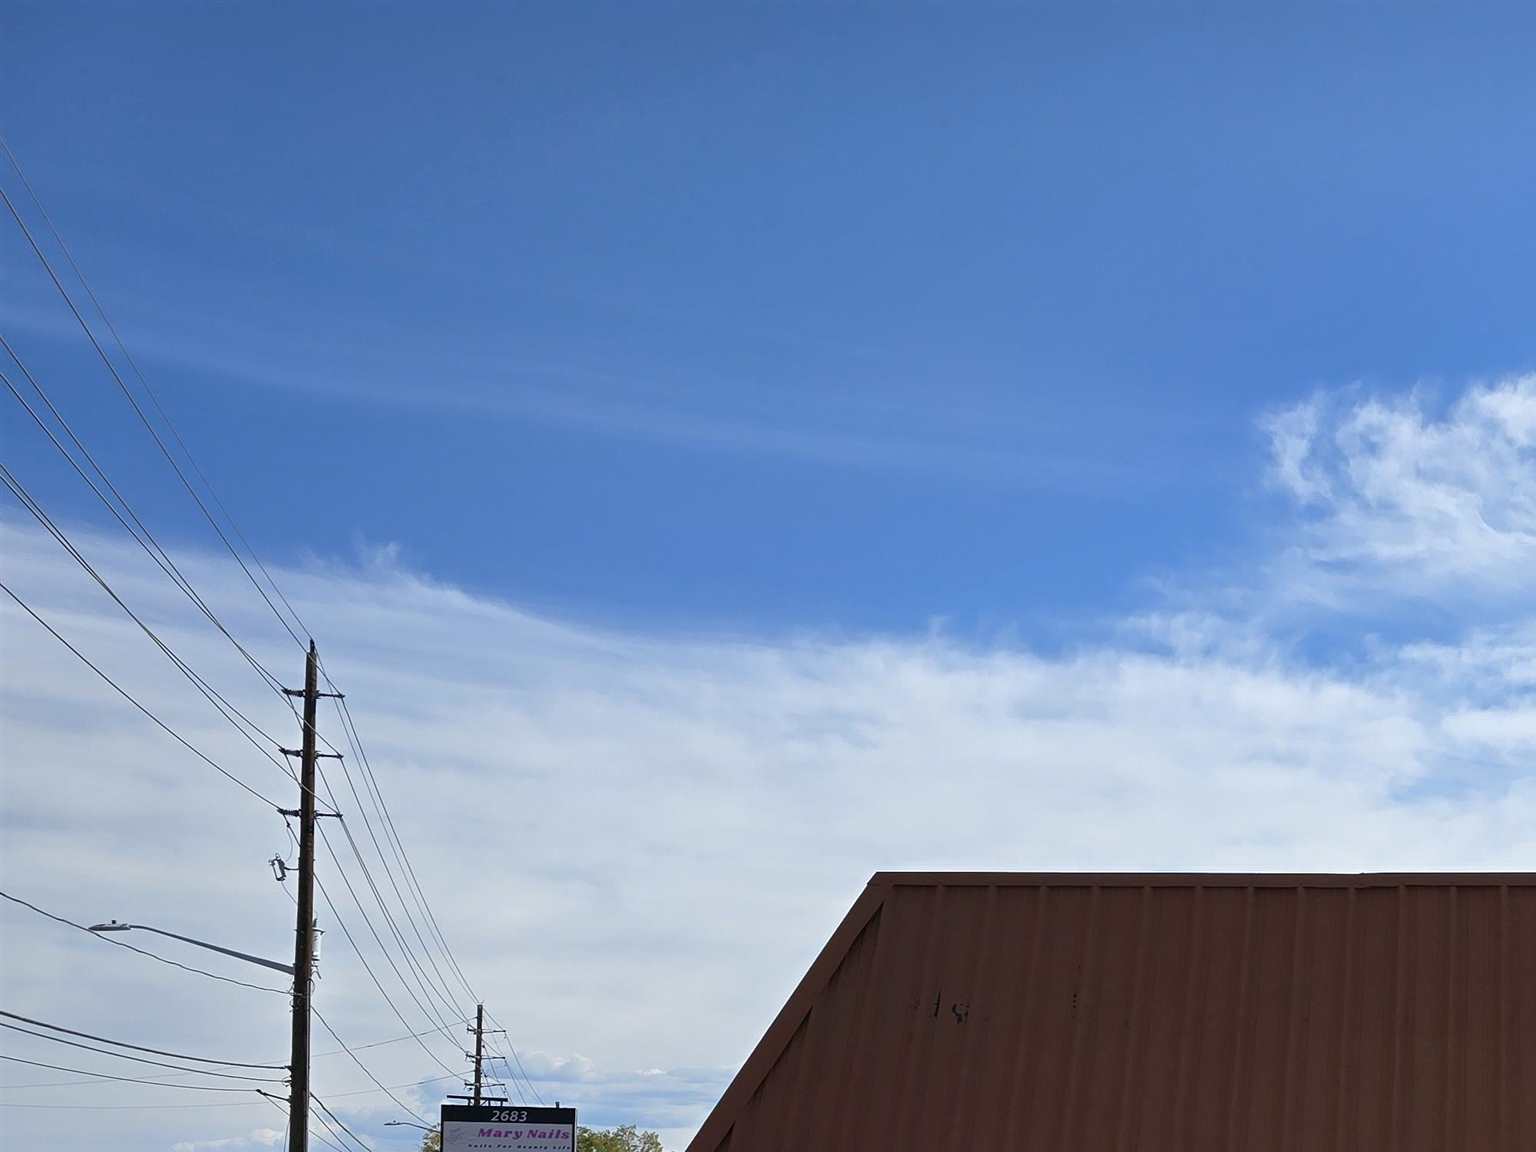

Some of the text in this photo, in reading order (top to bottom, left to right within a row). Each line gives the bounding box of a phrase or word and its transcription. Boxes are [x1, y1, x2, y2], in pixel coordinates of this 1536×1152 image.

[491, 1110, 528, 1122] 2683
[478, 1128, 570, 1140] Mary Nails
